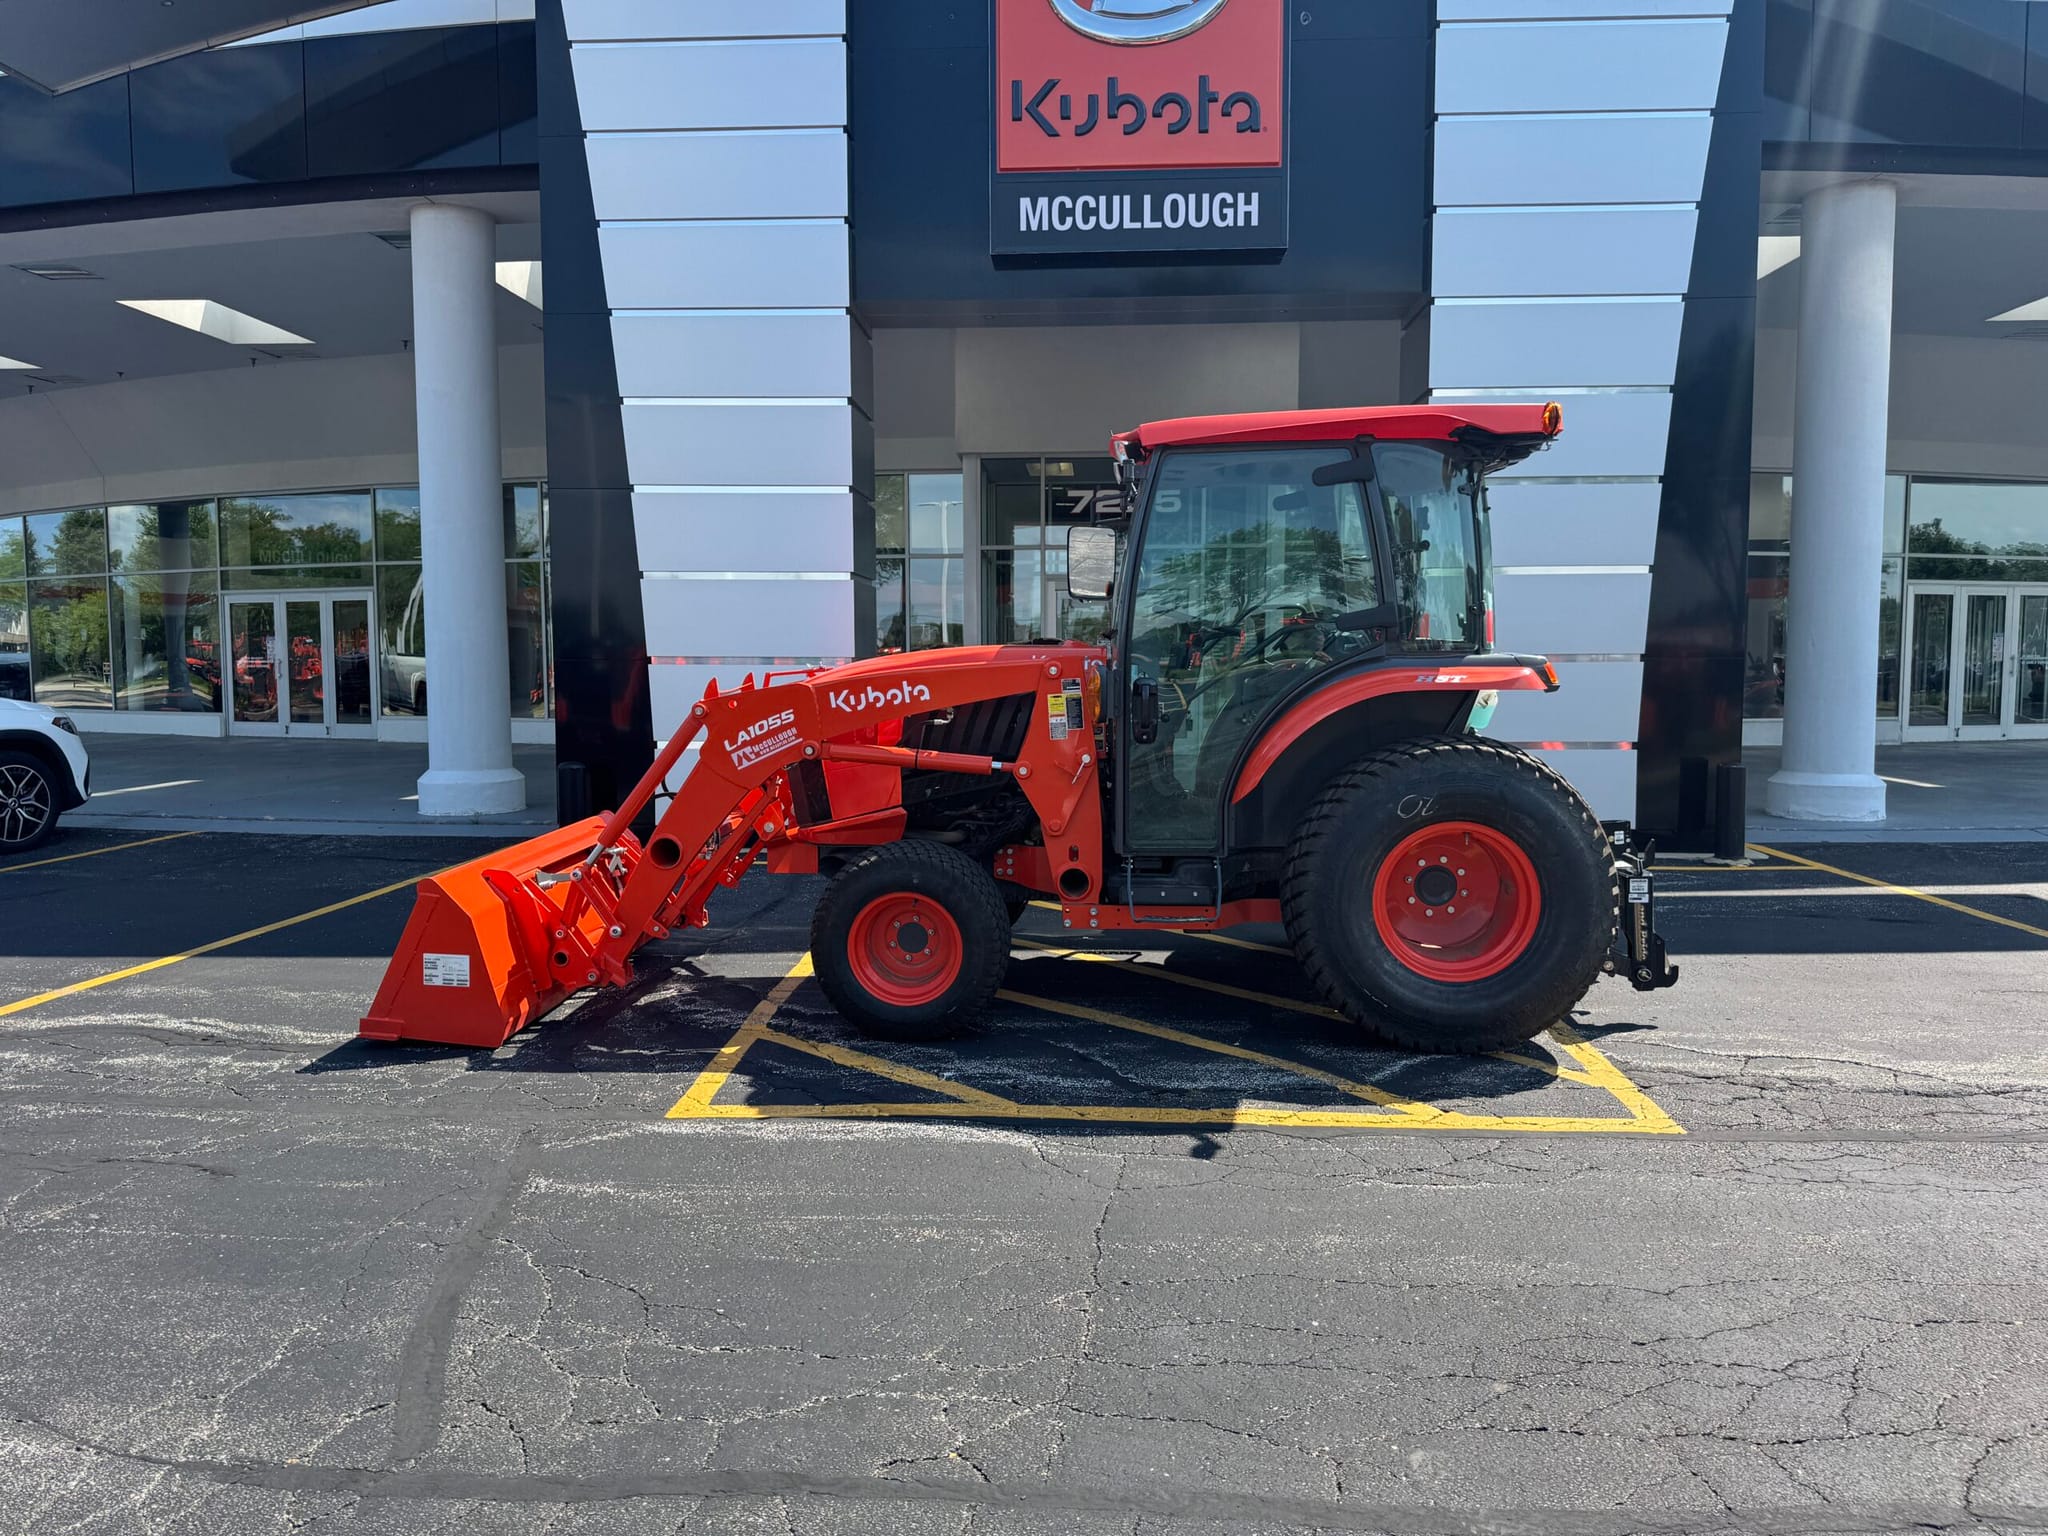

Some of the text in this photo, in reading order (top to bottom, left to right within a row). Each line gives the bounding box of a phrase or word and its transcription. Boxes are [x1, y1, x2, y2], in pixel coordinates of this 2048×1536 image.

[1011, 75, 1261, 137] Kubota
[1019, 192, 1259, 232] MCCULLOUGH
[1067, 489, 1182, 514] 725
[829, 680, 931, 713] Kubota
[1416, 675, 1467, 684] HST
[723, 708, 795, 752] LA1055
